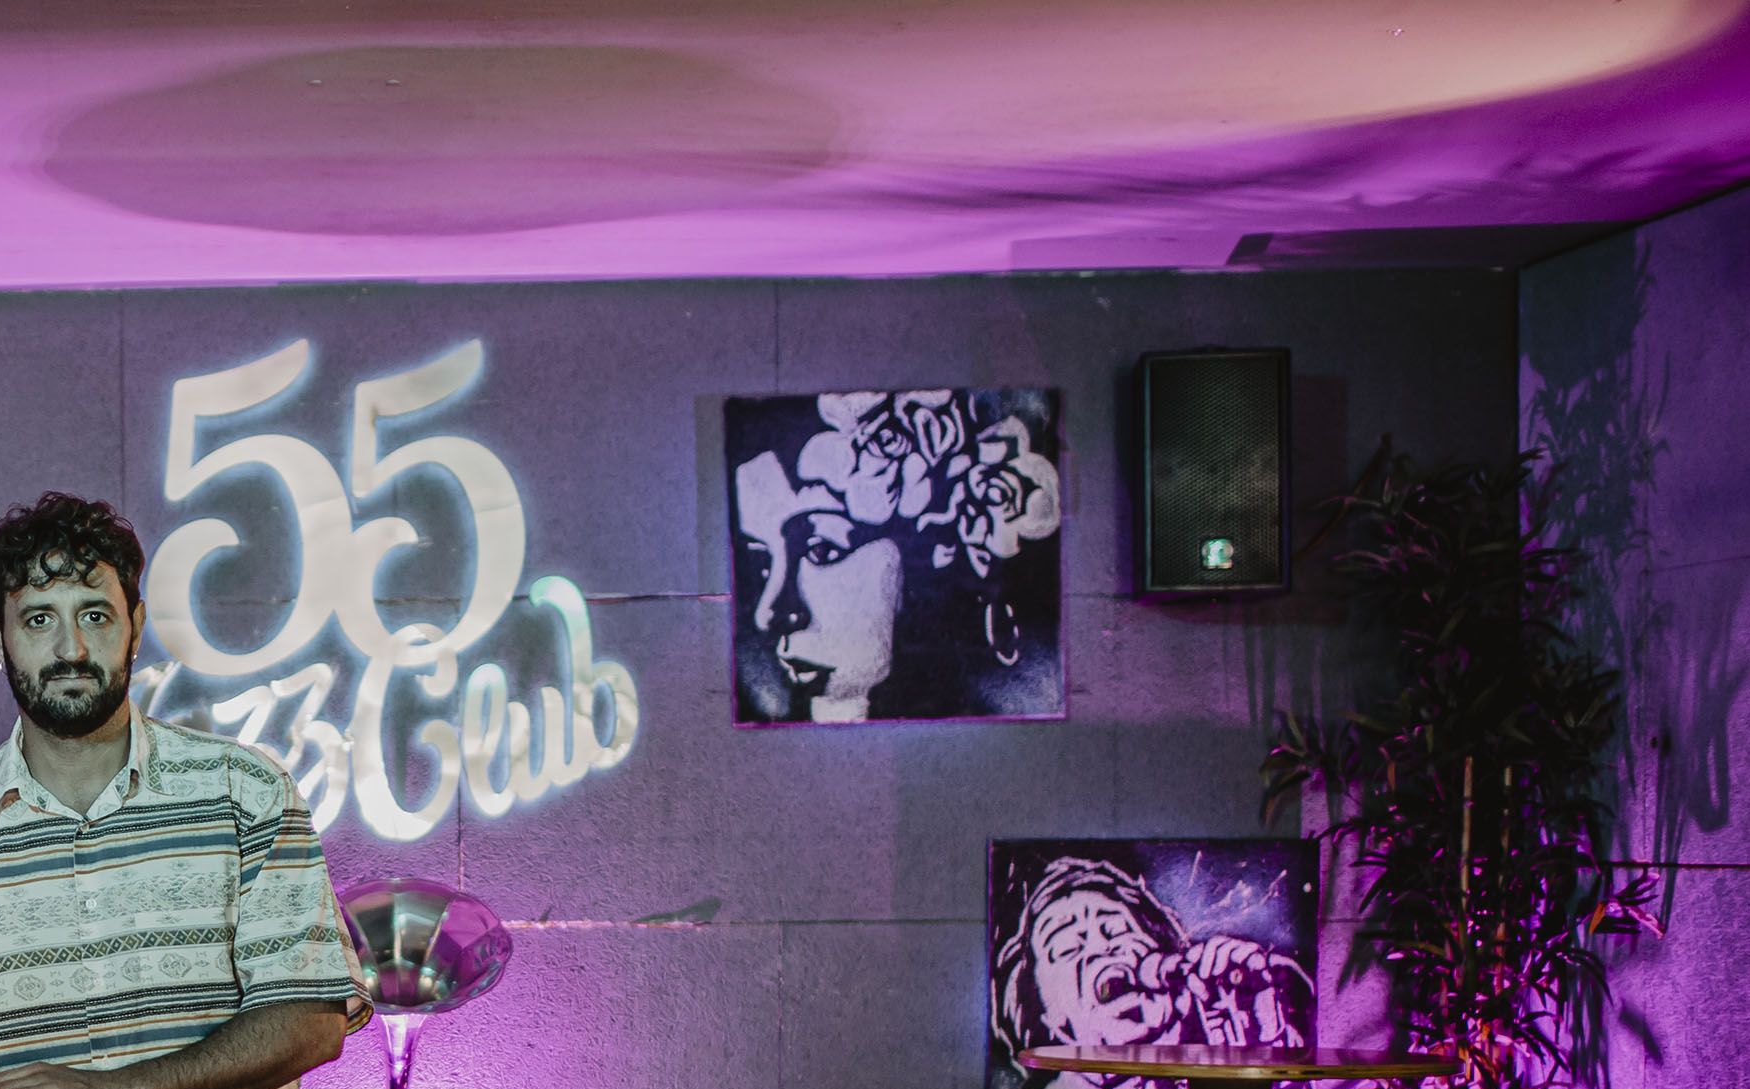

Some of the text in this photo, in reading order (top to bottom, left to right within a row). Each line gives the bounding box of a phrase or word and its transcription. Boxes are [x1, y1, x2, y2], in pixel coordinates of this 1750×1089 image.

[147, 338, 526, 677] 55
[128, 575, 639, 842] zz Club
